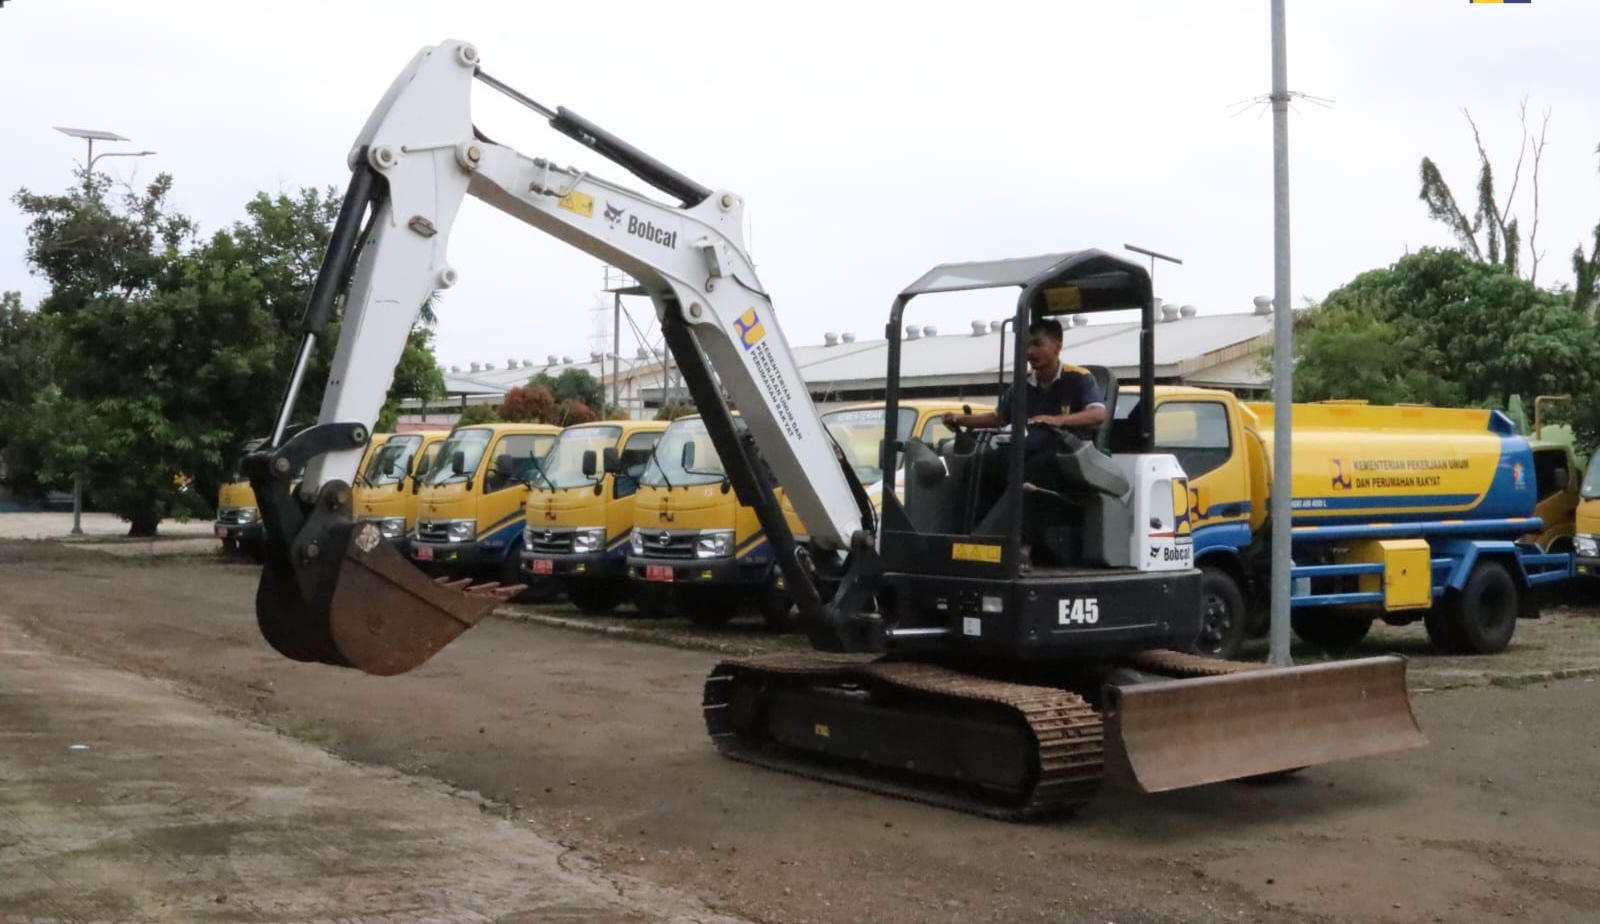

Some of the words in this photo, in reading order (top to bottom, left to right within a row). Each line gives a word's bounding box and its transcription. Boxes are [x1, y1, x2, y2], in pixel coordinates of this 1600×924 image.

[627, 214, 678, 250] Bobcat
[761, 340, 792, 401] KEMENTERIAN
[750, 350, 778, 403] PERUMAHAN
[775, 403, 794, 437] RAKYAT
[756, 345, 782, 396] PEKERJAAN
[779, 396, 794, 422] UMUM
[791, 422, 803, 440] DAN
[1353, 459, 1406, 471] KEMENTERIAN
[1406, 458, 1448, 470] PEKERJAAN
[1448, 458, 1469, 469] UMUM
[1355, 477, 1370, 488] DAN
[1371, 476, 1415, 488] PERUMAHAN
[1415, 475, 1441, 486] RAKYAT
[1164, 546, 1190, 562] Bobcat
[1058, 598, 1099, 625] E45
